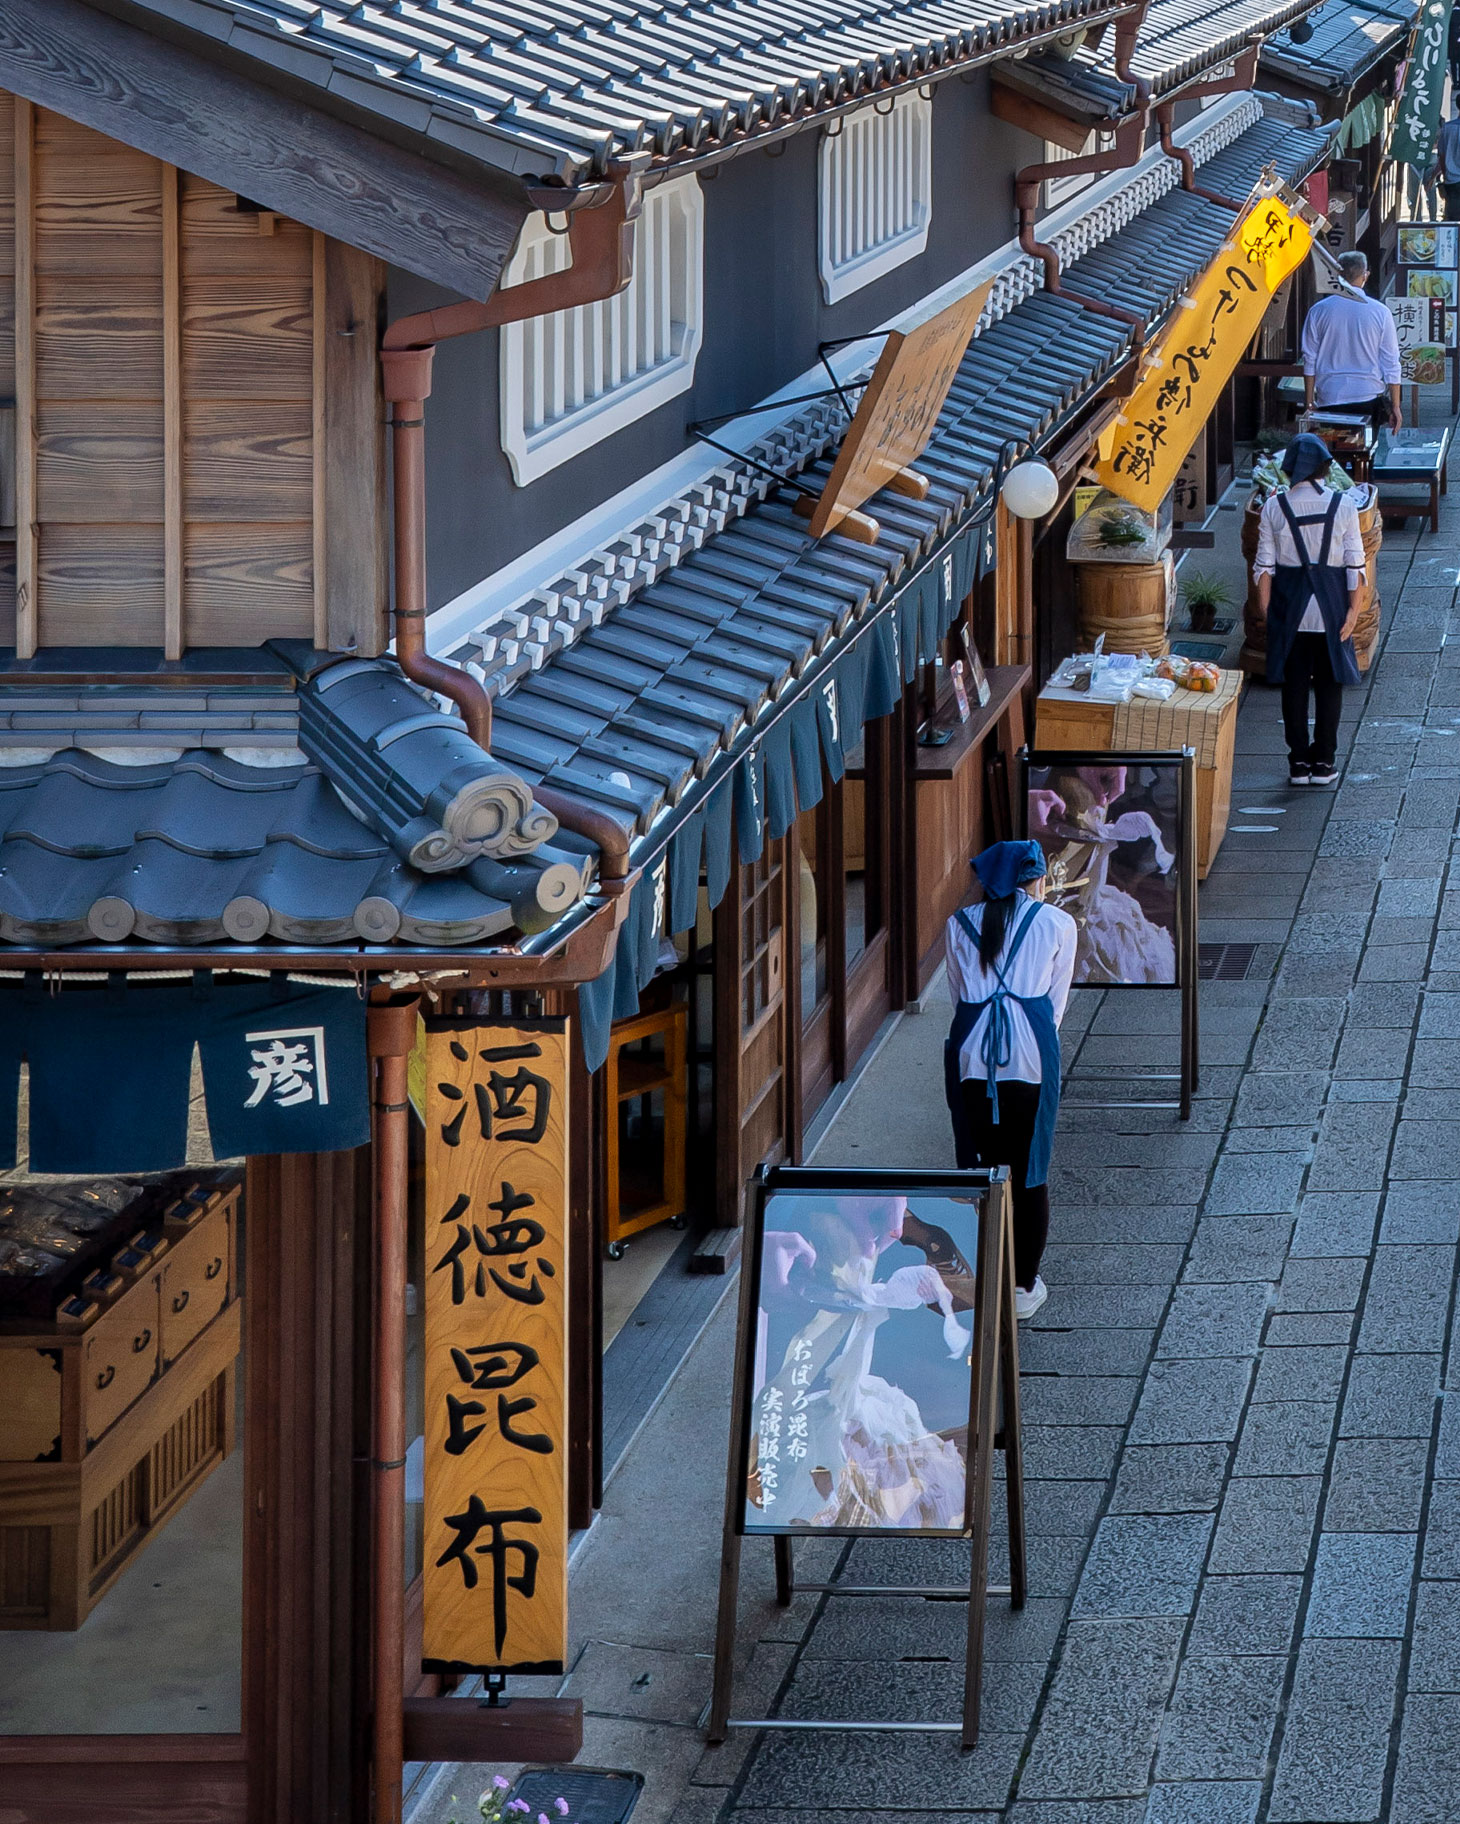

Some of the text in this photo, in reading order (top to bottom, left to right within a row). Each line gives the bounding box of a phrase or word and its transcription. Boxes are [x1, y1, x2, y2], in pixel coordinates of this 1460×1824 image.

[1392, 303, 1417, 380] 横丁そば
[433, 1040, 555, 1661] 酒徳昆布
[786, 1339, 814, 1463] おぼろ昆布
[755, 1386, 784, 1514] 実演販売中
